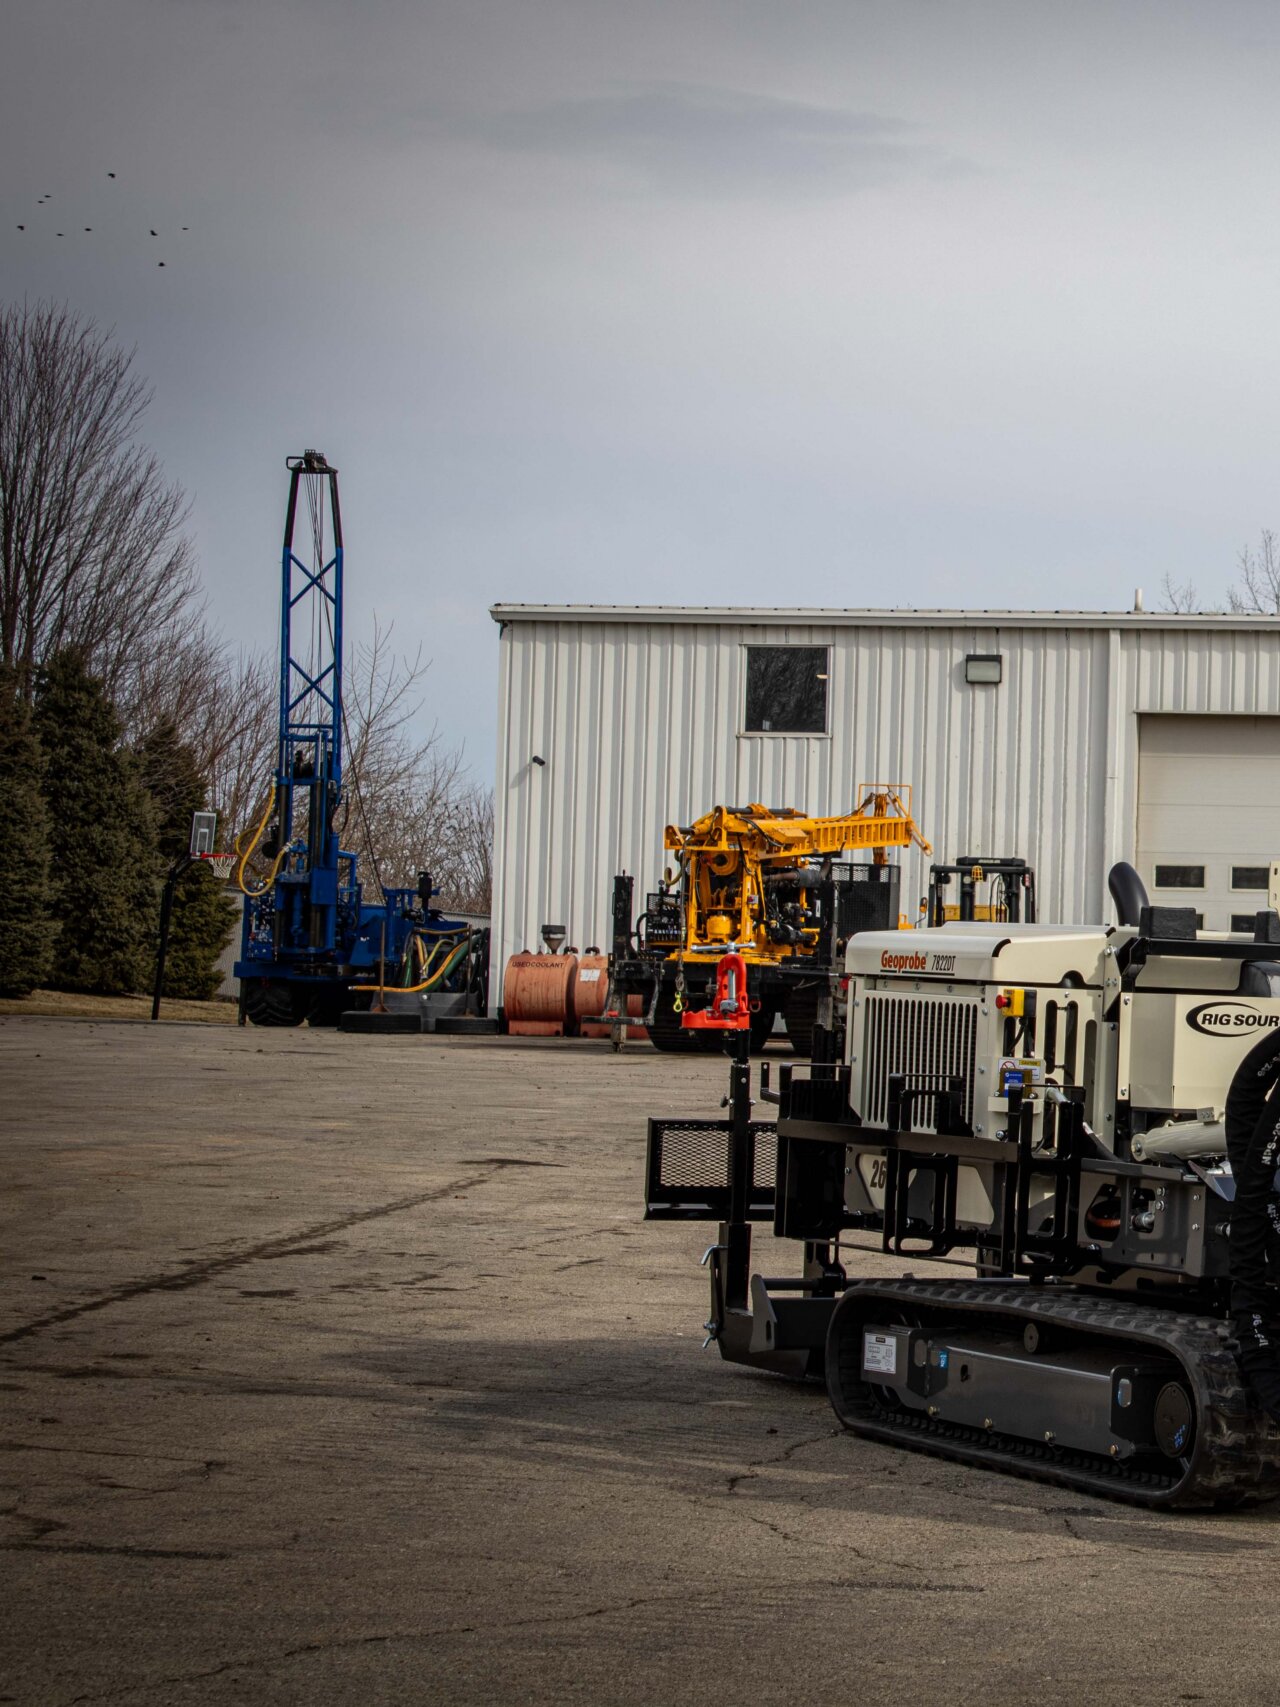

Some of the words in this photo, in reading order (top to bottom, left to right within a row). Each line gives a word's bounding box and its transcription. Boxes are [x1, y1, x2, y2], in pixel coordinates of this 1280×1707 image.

[881, 950, 927, 973] Geoprobe
[931, 954, 956, 972] 7822DT
[1201, 1013, 1232, 1026] RIG
[870, 1159, 887, 1189] 26
